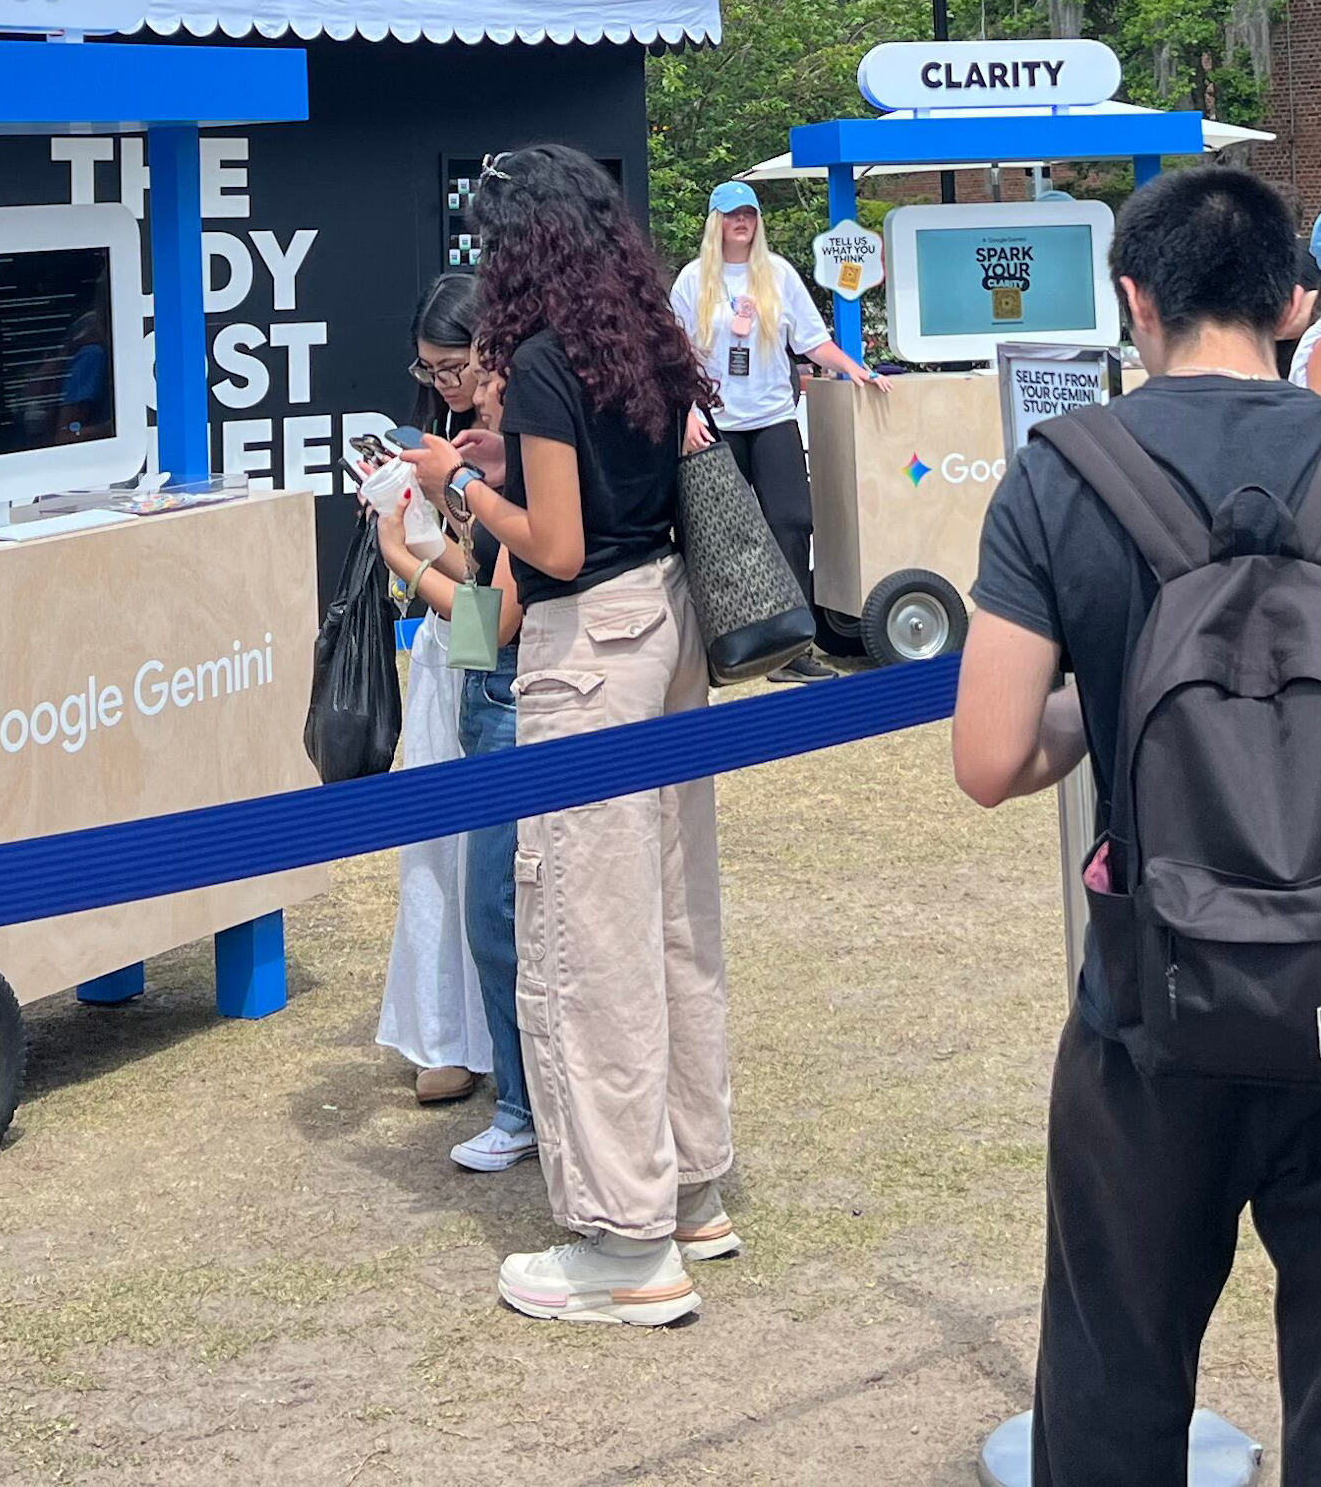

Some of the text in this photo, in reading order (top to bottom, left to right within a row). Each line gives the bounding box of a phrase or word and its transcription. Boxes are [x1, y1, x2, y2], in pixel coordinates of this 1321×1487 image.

[921, 61, 1065, 89] CLARITY
[828, 236, 867, 247] TELL US
[822, 245, 876, 255] WHAT YOU
[976, 246, 1034, 262] SPARK
[833, 255, 865, 264] THINK
[980, 262, 1031, 277] YOUR
[987, 278, 1024, 289] CLARITY
[1016, 370, 1099, 388] SELECT 1 FROM
[1020, 385, 1096, 402] YOUR GEMINI
[1023, 400, 1057, 414] STUDY
[941, 453, 1007, 484] Goo
[134, 631, 273, 716] Gemini
